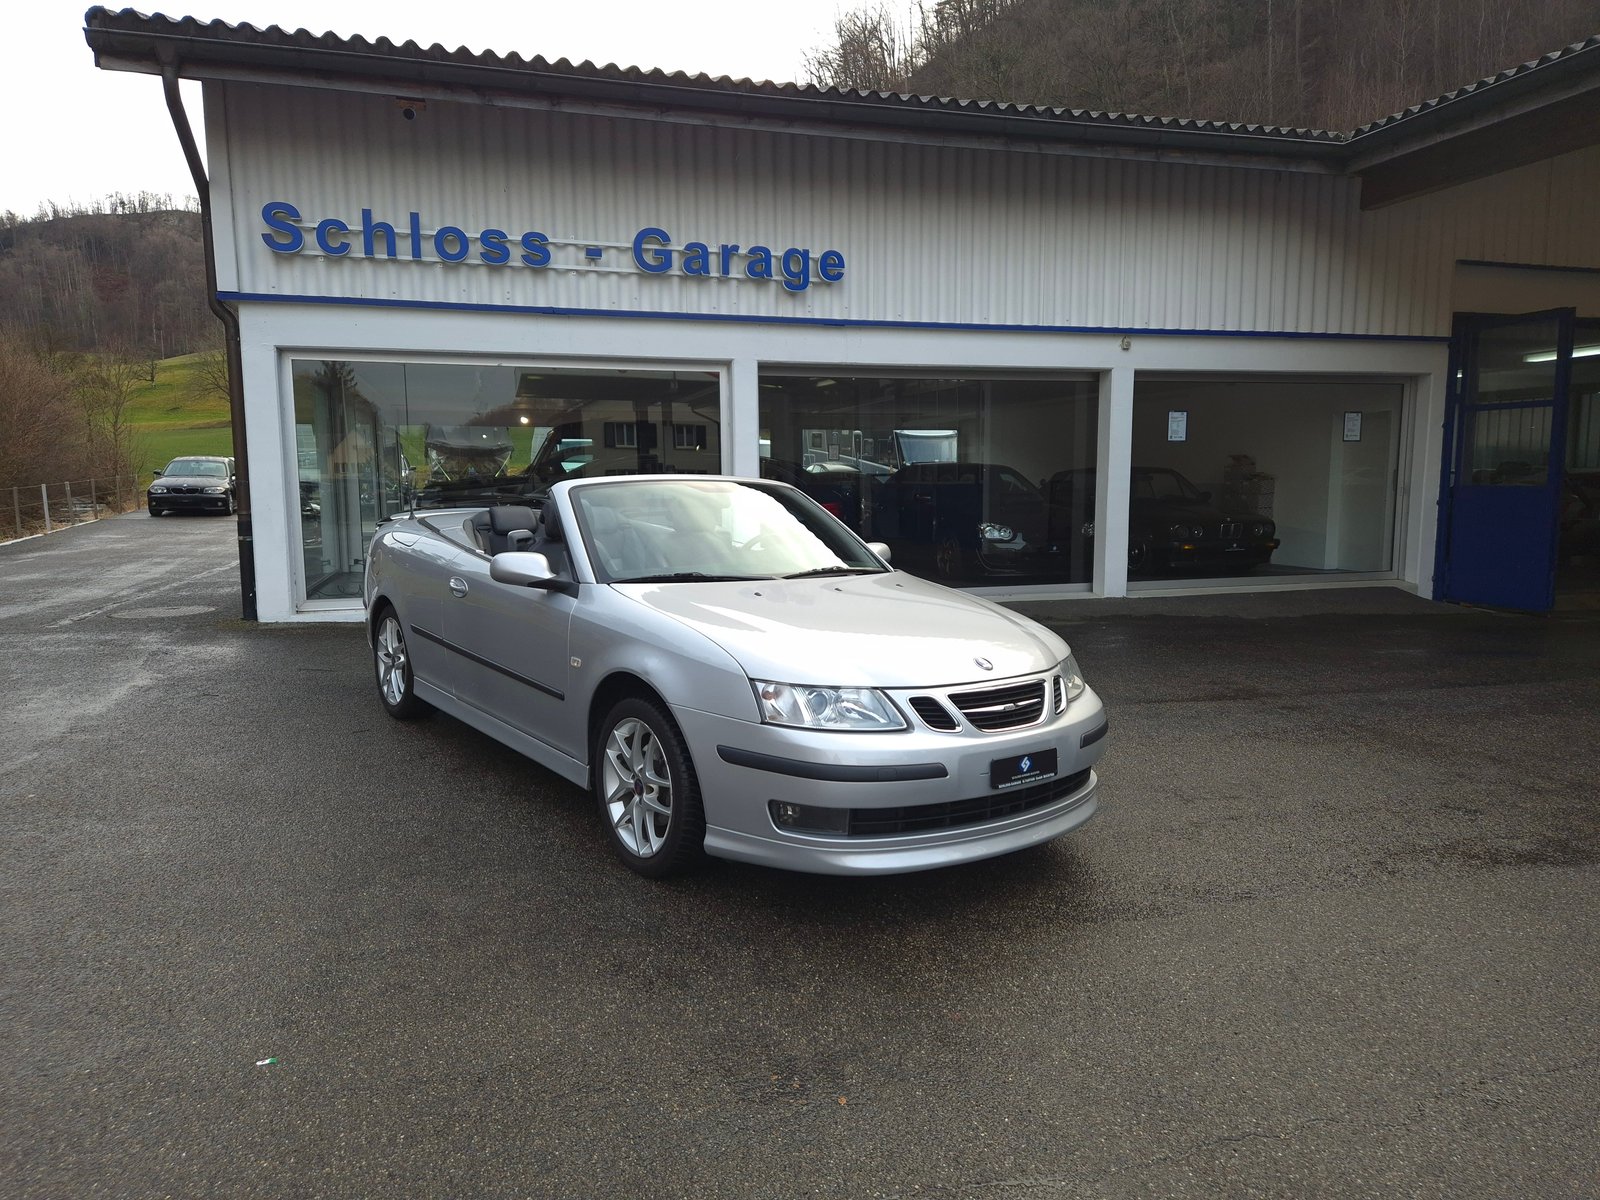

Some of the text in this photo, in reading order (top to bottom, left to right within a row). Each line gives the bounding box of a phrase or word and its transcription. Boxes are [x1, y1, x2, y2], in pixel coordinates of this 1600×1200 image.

[261, 201, 846, 292] Schloss - Garage
